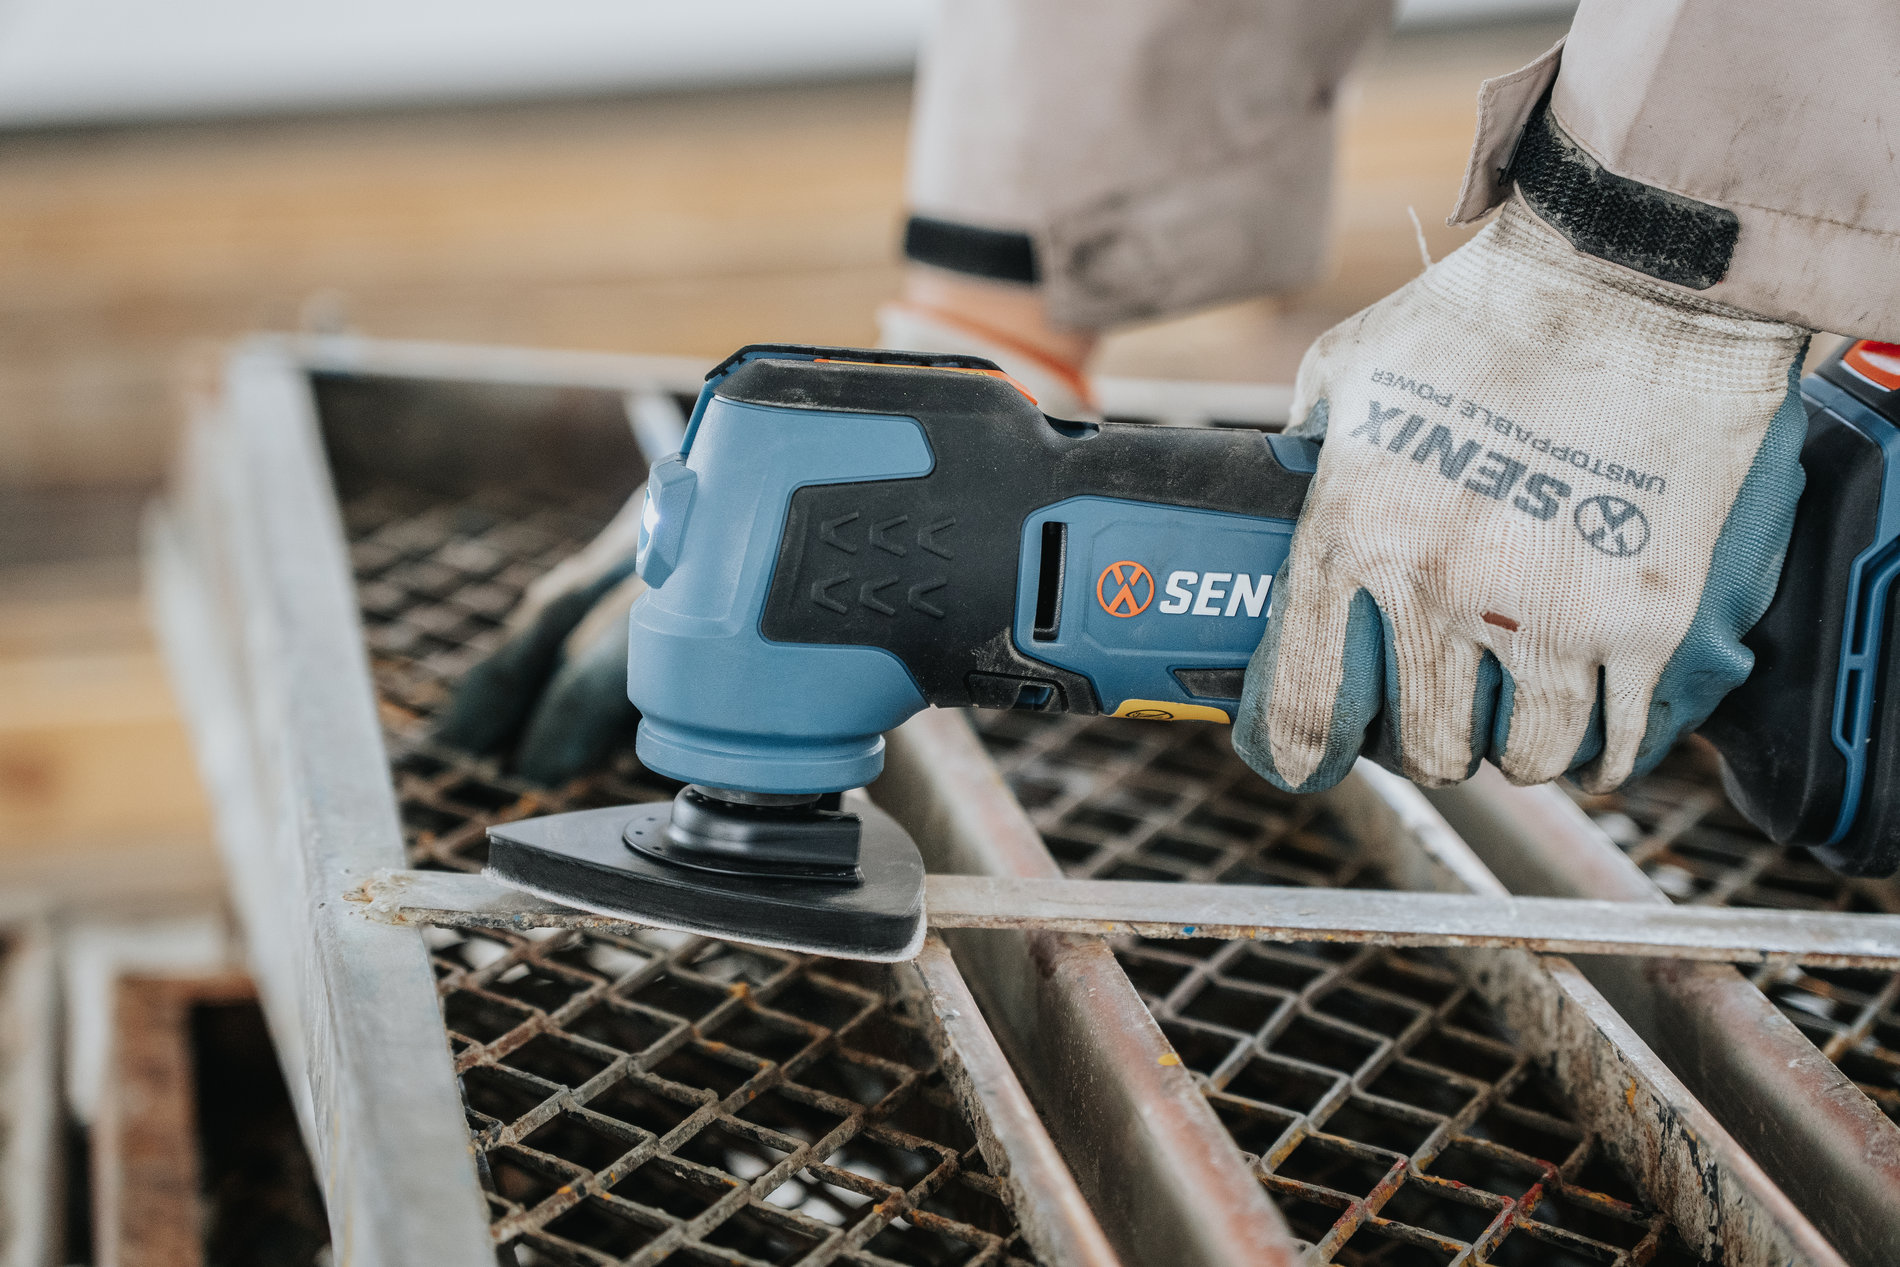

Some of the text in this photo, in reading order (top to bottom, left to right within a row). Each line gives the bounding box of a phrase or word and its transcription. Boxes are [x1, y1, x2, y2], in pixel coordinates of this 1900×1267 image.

[1351, 400, 1572, 521] SENIX
[1371, 368, 1667, 494] UNSTOPPABLE POWER
[1159, 570, 1273, 618] SEN
